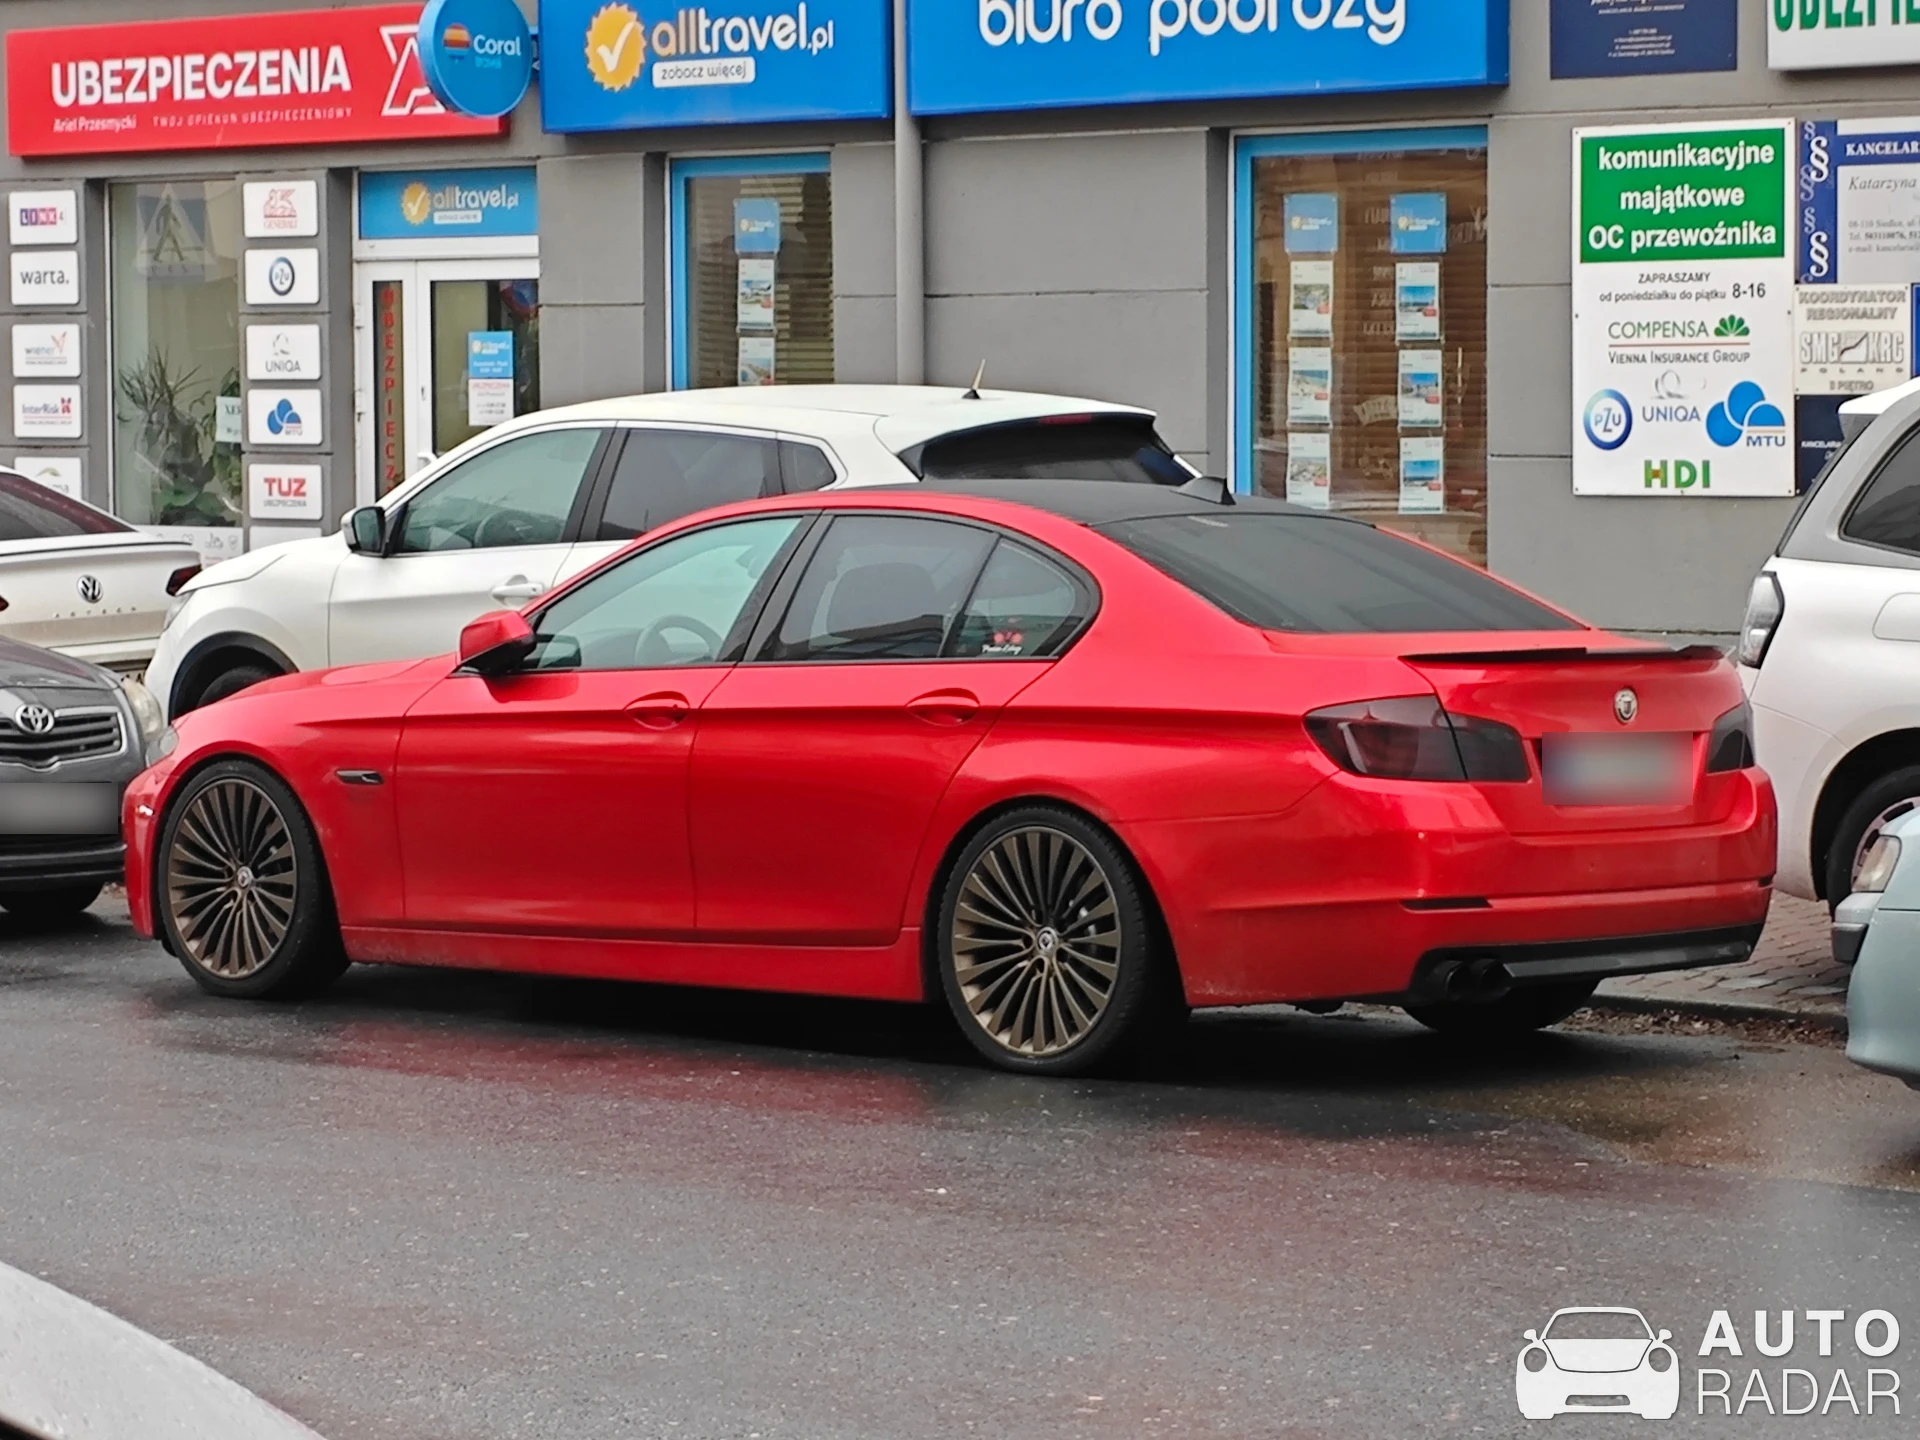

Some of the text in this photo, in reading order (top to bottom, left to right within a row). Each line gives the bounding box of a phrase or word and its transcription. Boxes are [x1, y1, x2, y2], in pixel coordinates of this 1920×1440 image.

[652, 2, 834, 56] alltravel.pl
[473, 34, 521, 56] Coral
[51, 45, 351, 107] UBEZPIECZENIA
[662, 61, 747, 80] zobacz więcej
[1599, 140, 1775, 171] komunikacyjne
[1848, 176, 1917, 193] Katarzyna
[1620, 183, 1745, 215] majątkowe
[1588, 220, 1776, 254] OC przewoźnika
[1638, 272, 1711, 284] ZAPRASZAMY
[1599, 282, 1767, 303] od poniedziałku do piątku 8-16
[1799, 290, 1906, 304] KOORDYNATOR
[1806, 307, 1898, 321] REGIONALNY
[1608, 320, 1709, 339] COMPENSA
[265, 359, 302, 372] UNIQA
[1594, 407, 1622, 433] PZU
[1642, 405, 1701, 423] UNIQA
[1746, 435, 1786, 447] MTU
[1644, 459, 1711, 488] HDI
[263, 477, 307, 497] TUZ
